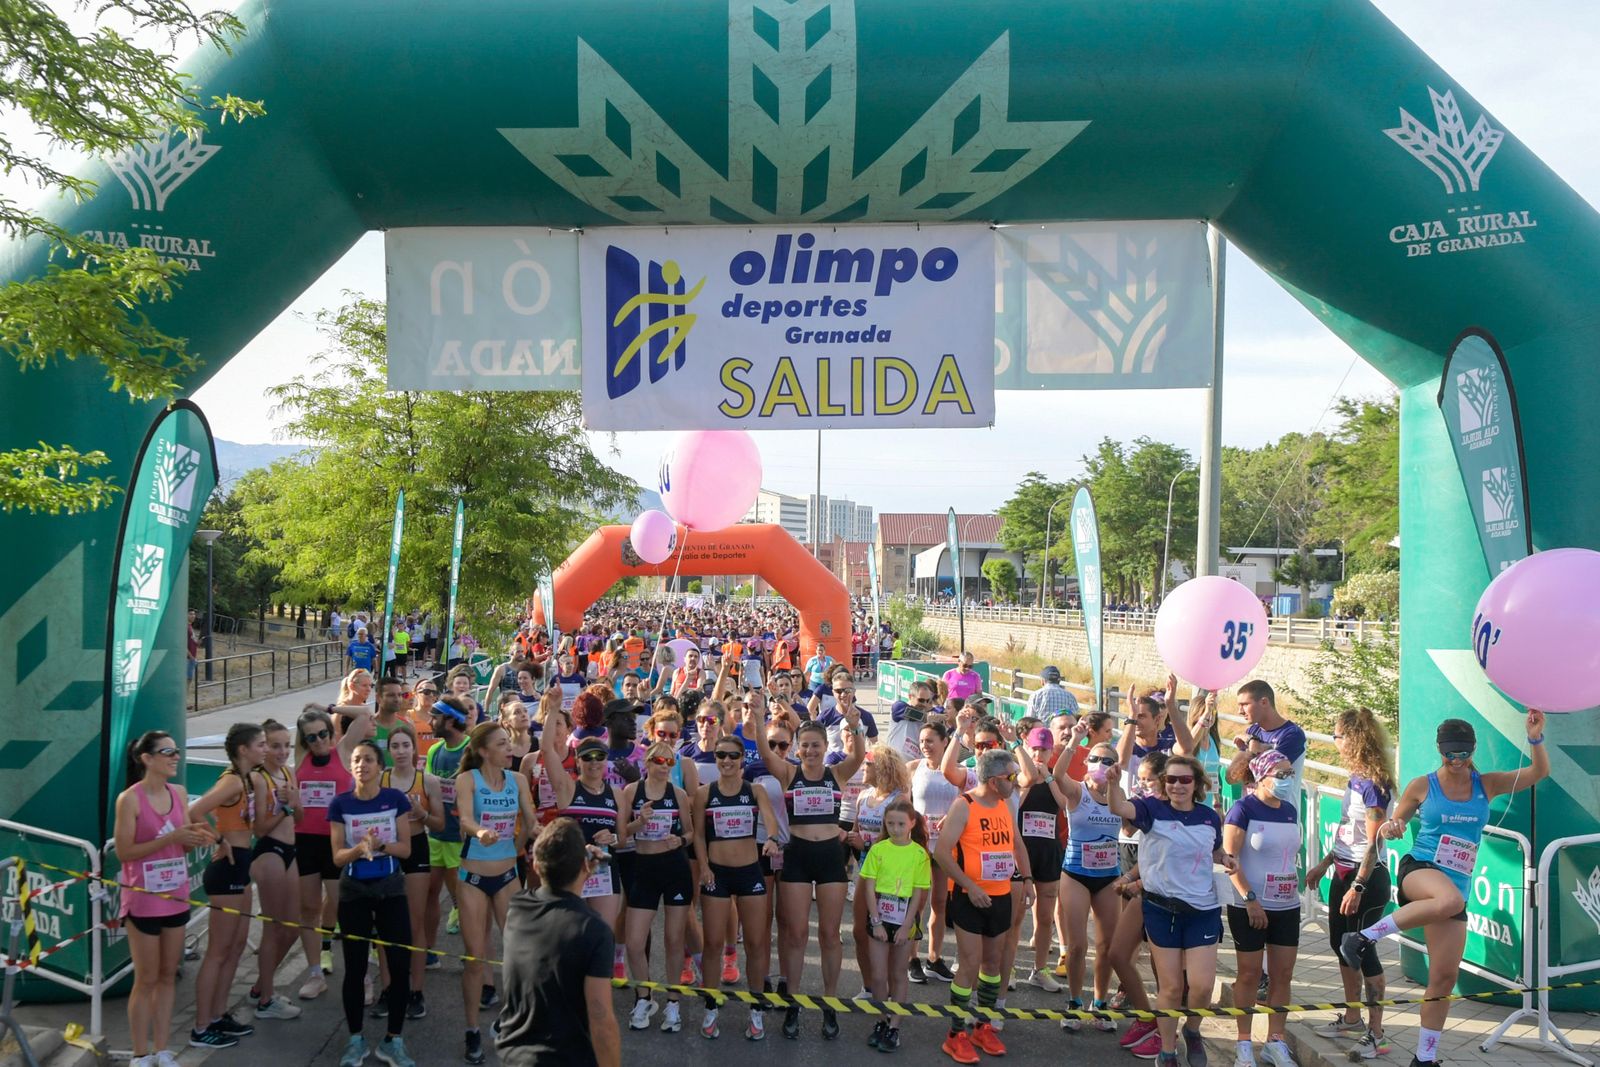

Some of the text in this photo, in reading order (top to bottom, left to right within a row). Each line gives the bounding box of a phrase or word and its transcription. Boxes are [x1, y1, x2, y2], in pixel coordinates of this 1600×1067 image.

[1389, 210, 1537, 243] CAJA RURAL
[139, 233, 216, 257] RURAL
[1407, 231, 1526, 257] DE GRANADA
[729, 233, 959, 296] olimpo
[721, 293, 868, 324] deportes
[784, 325, 892, 345] Granada
[718, 354, 976, 419] SALIDA
[701, 552, 711, 560] de
[713, 551, 747, 560] Deportes
[1221, 620, 1254, 661] 35'
[482, 797, 516, 807] nerja
[980, 817, 1008, 832] RUN
[982, 831, 1010, 847] RUN
[995, 862, 1007, 870] 641
[881, 902, 895, 912] 265
